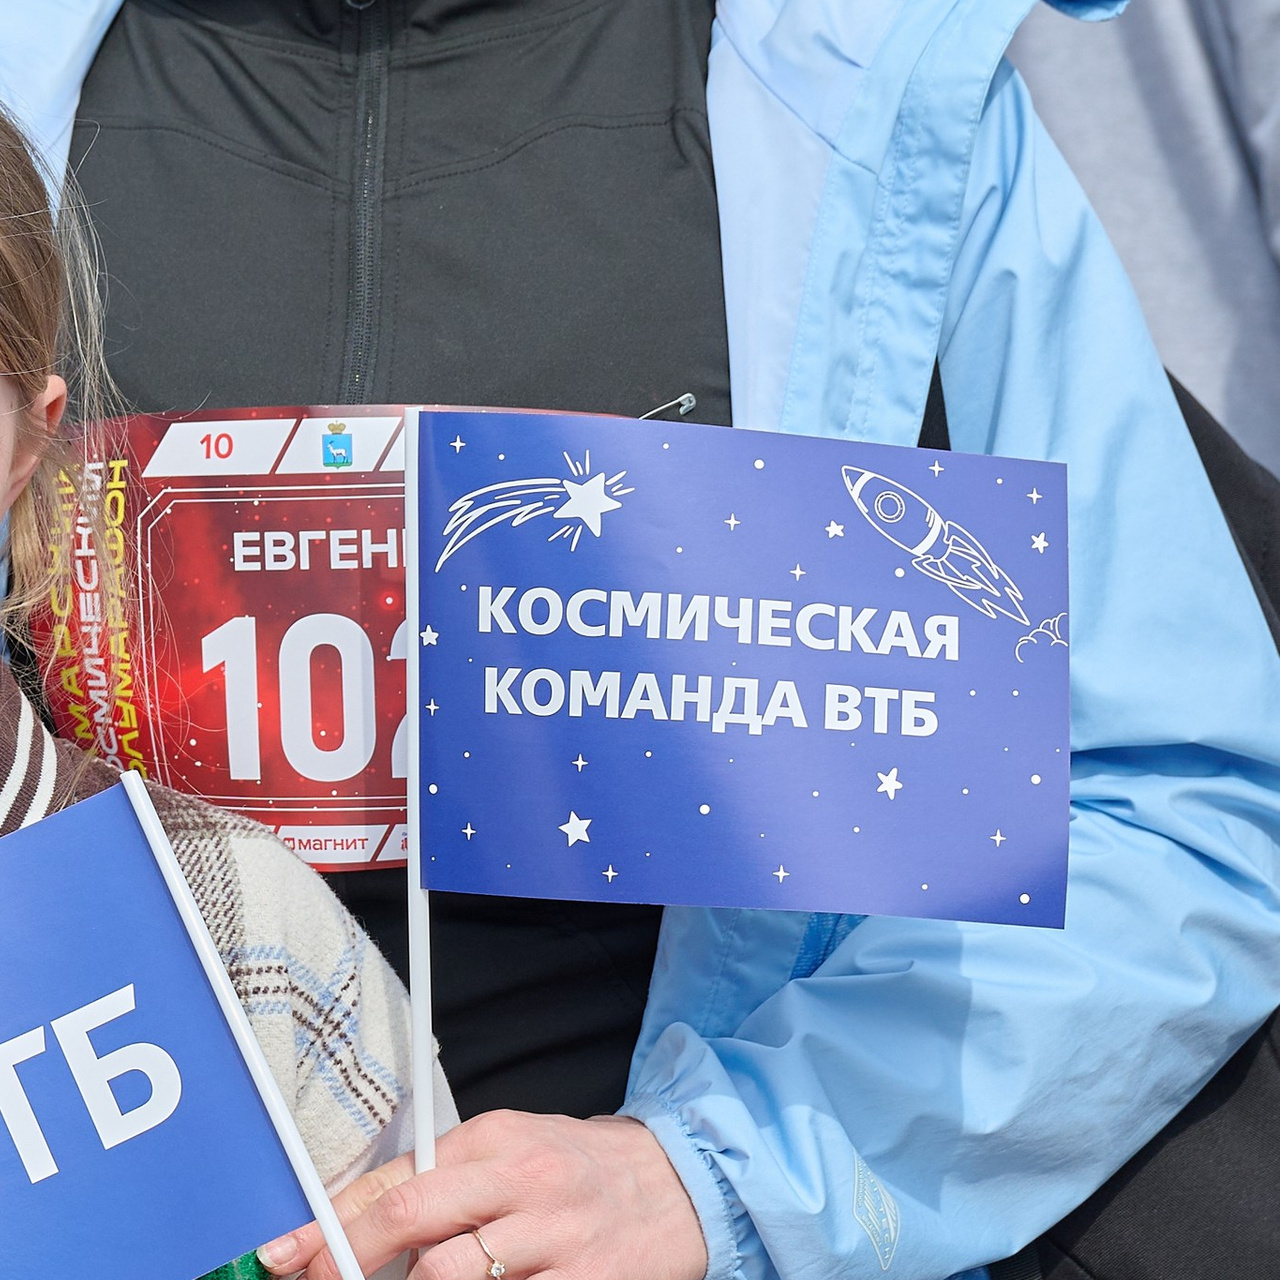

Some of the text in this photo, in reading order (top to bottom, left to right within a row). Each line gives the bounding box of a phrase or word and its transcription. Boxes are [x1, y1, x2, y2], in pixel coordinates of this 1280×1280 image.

[200, 433, 234, 459] 10
[233, 528, 407, 571] ЕВГЕН
[478, 585, 960, 662] КОСМИЧЕСКАЯ
[201, 613, 407, 783] 10
[483, 666, 939, 737] КОМАНДА ВТБ
[299, 838, 368, 850] магнит
